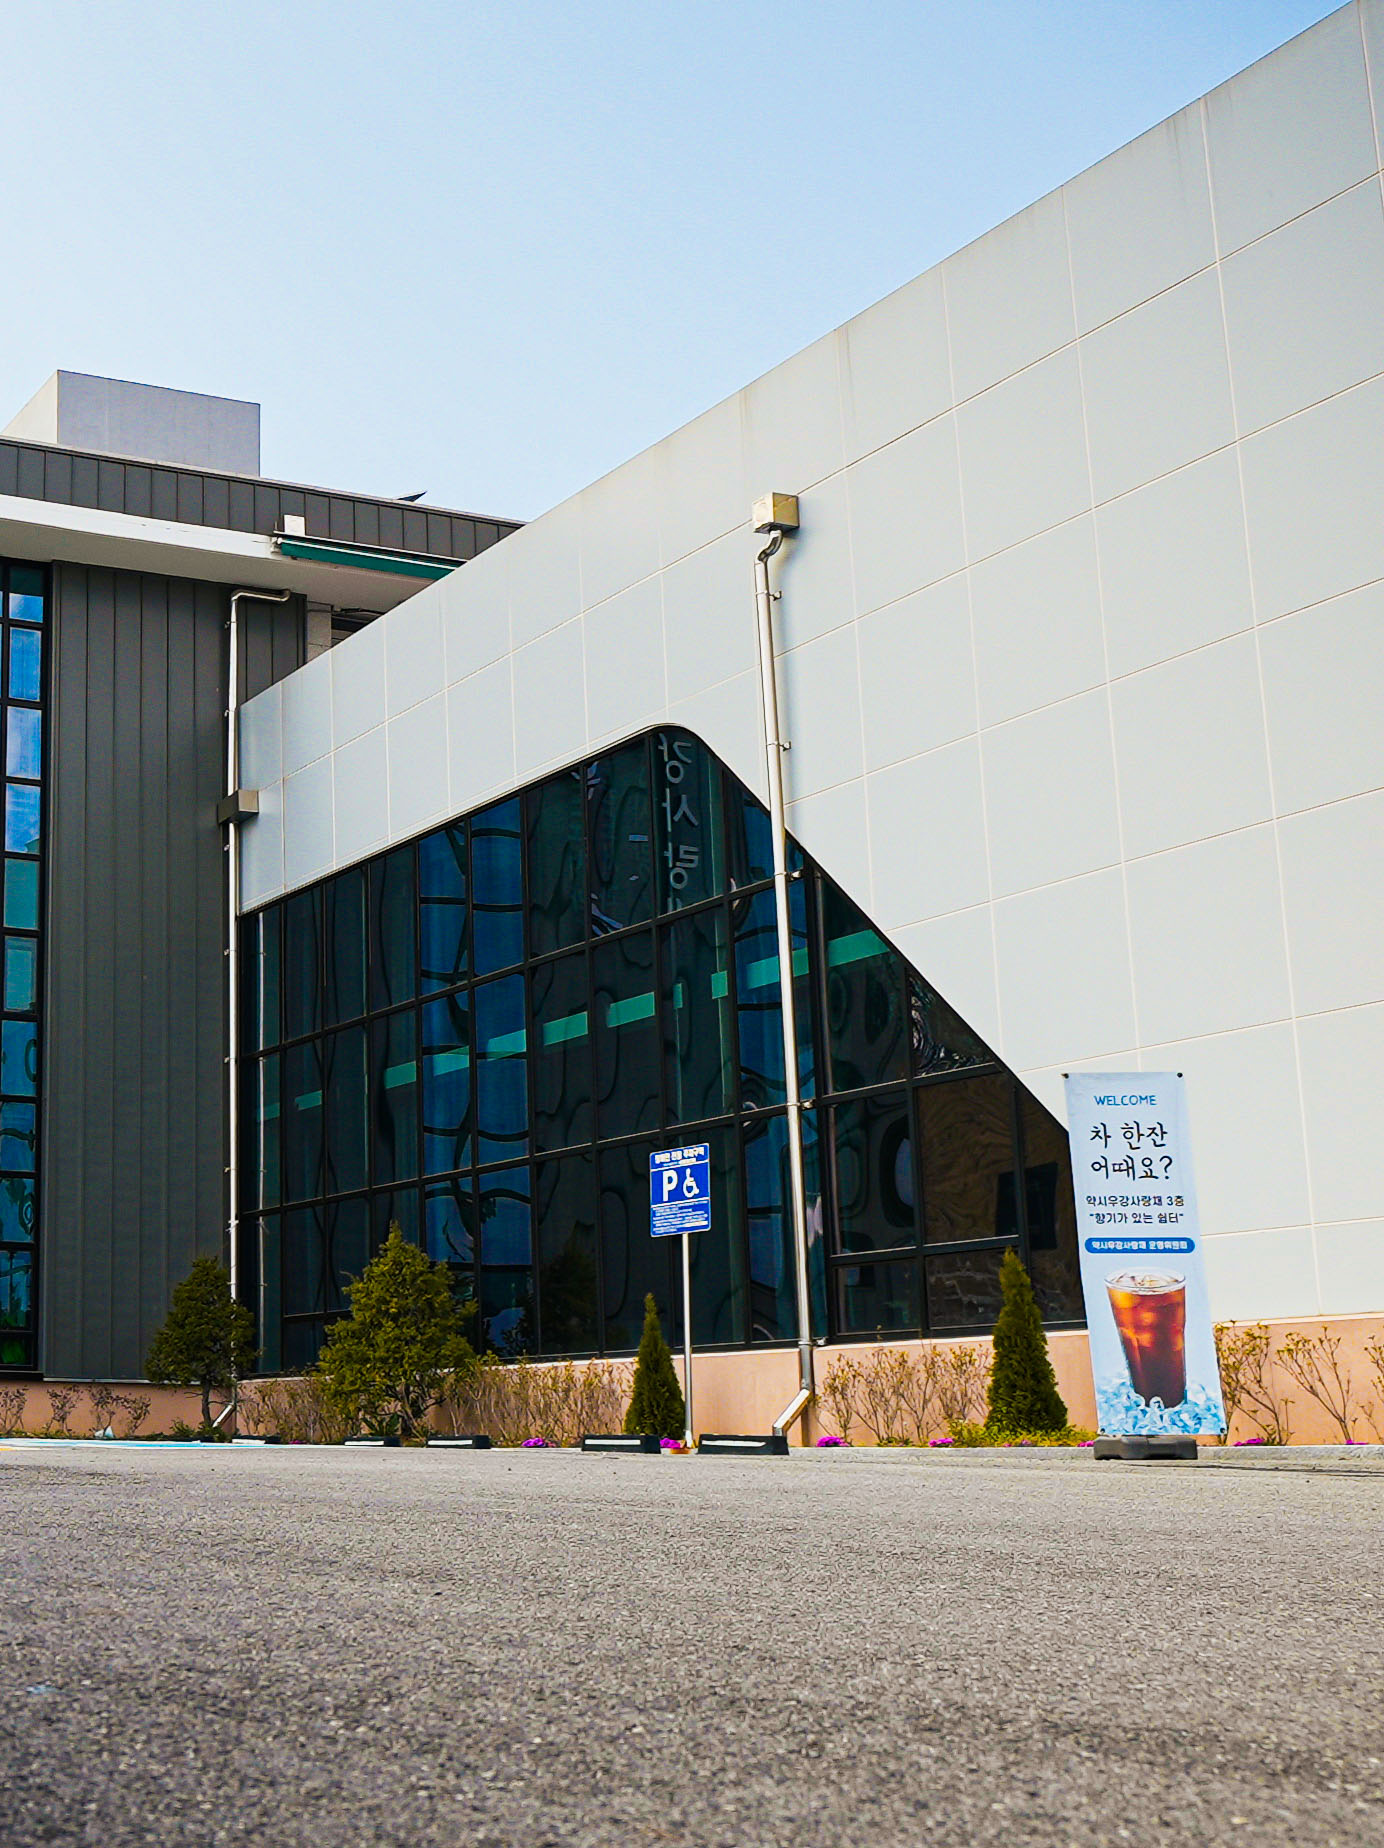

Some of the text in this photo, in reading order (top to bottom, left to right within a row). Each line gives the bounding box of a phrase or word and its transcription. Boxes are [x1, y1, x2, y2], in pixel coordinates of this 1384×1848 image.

[1093, 1094, 1157, 1106] WELCOME
[1090, 1120, 1168, 1150] 차 한잔
[1090, 1154, 1173, 1181] 어때요?
[662, 1169, 678, 1202] P
[1131, 1212, 1153, 1224] 있는
